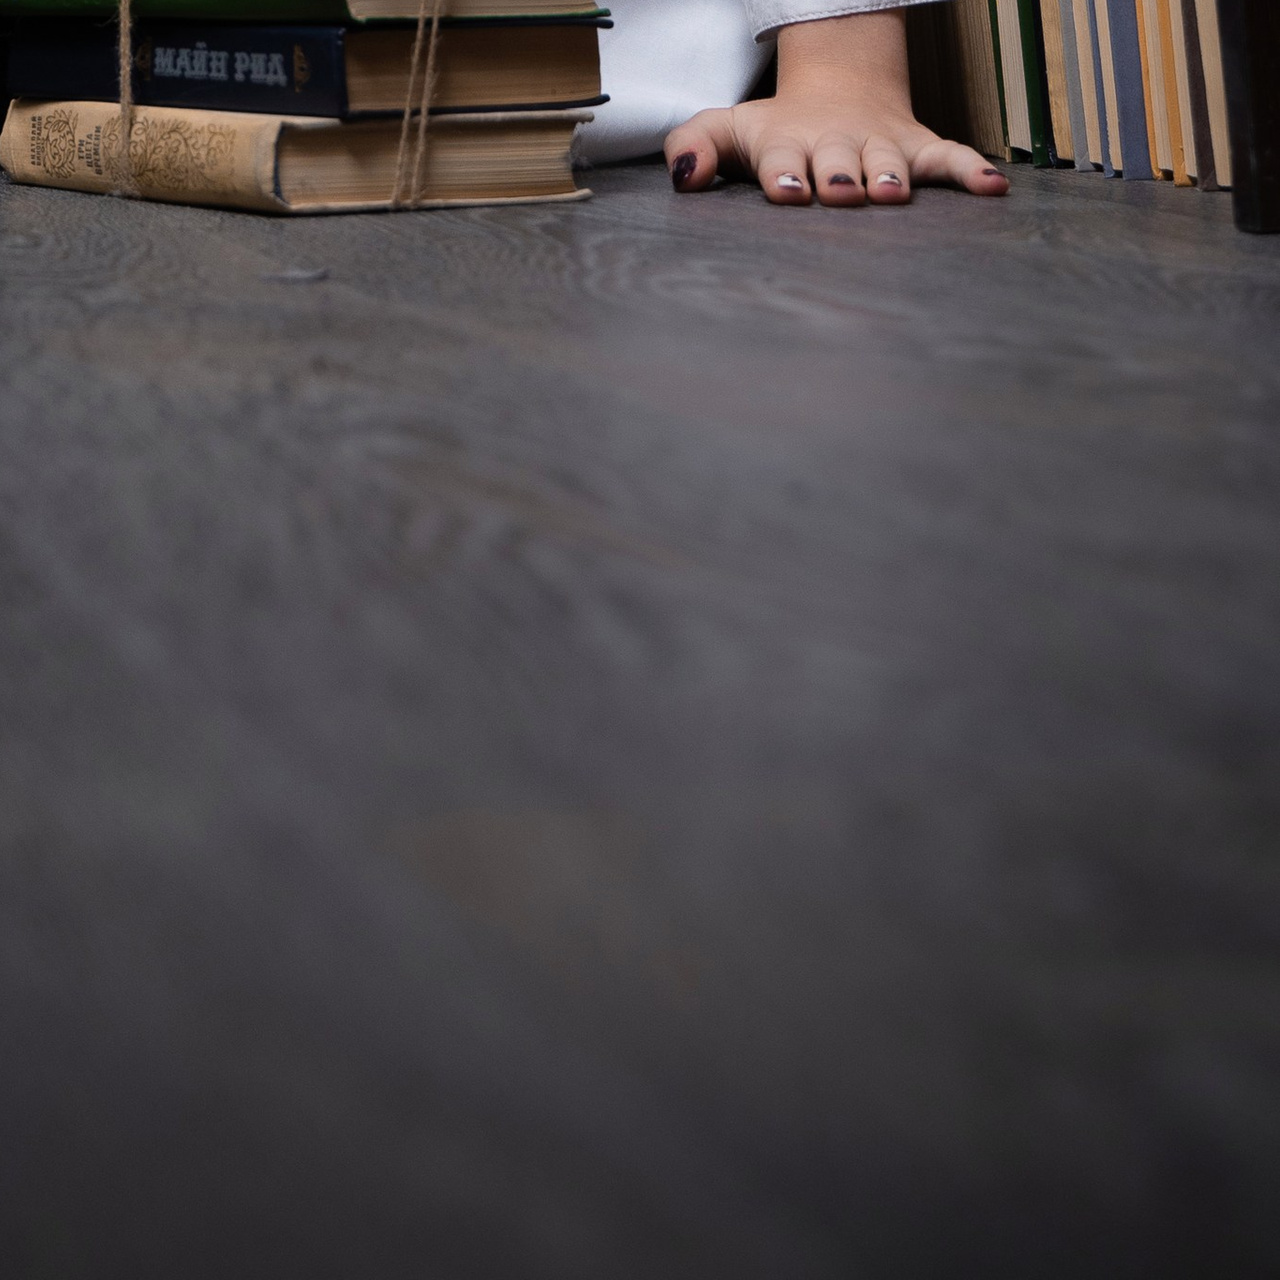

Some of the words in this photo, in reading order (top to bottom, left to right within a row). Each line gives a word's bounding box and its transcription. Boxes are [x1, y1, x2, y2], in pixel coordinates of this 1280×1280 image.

[154, 41, 229, 81] МАЙН
[233, 51, 288, 87] РИД
[85, 132, 93, 168] ЦВЕТА
[93, 125, 103, 176] ВРЕМЕНИ
